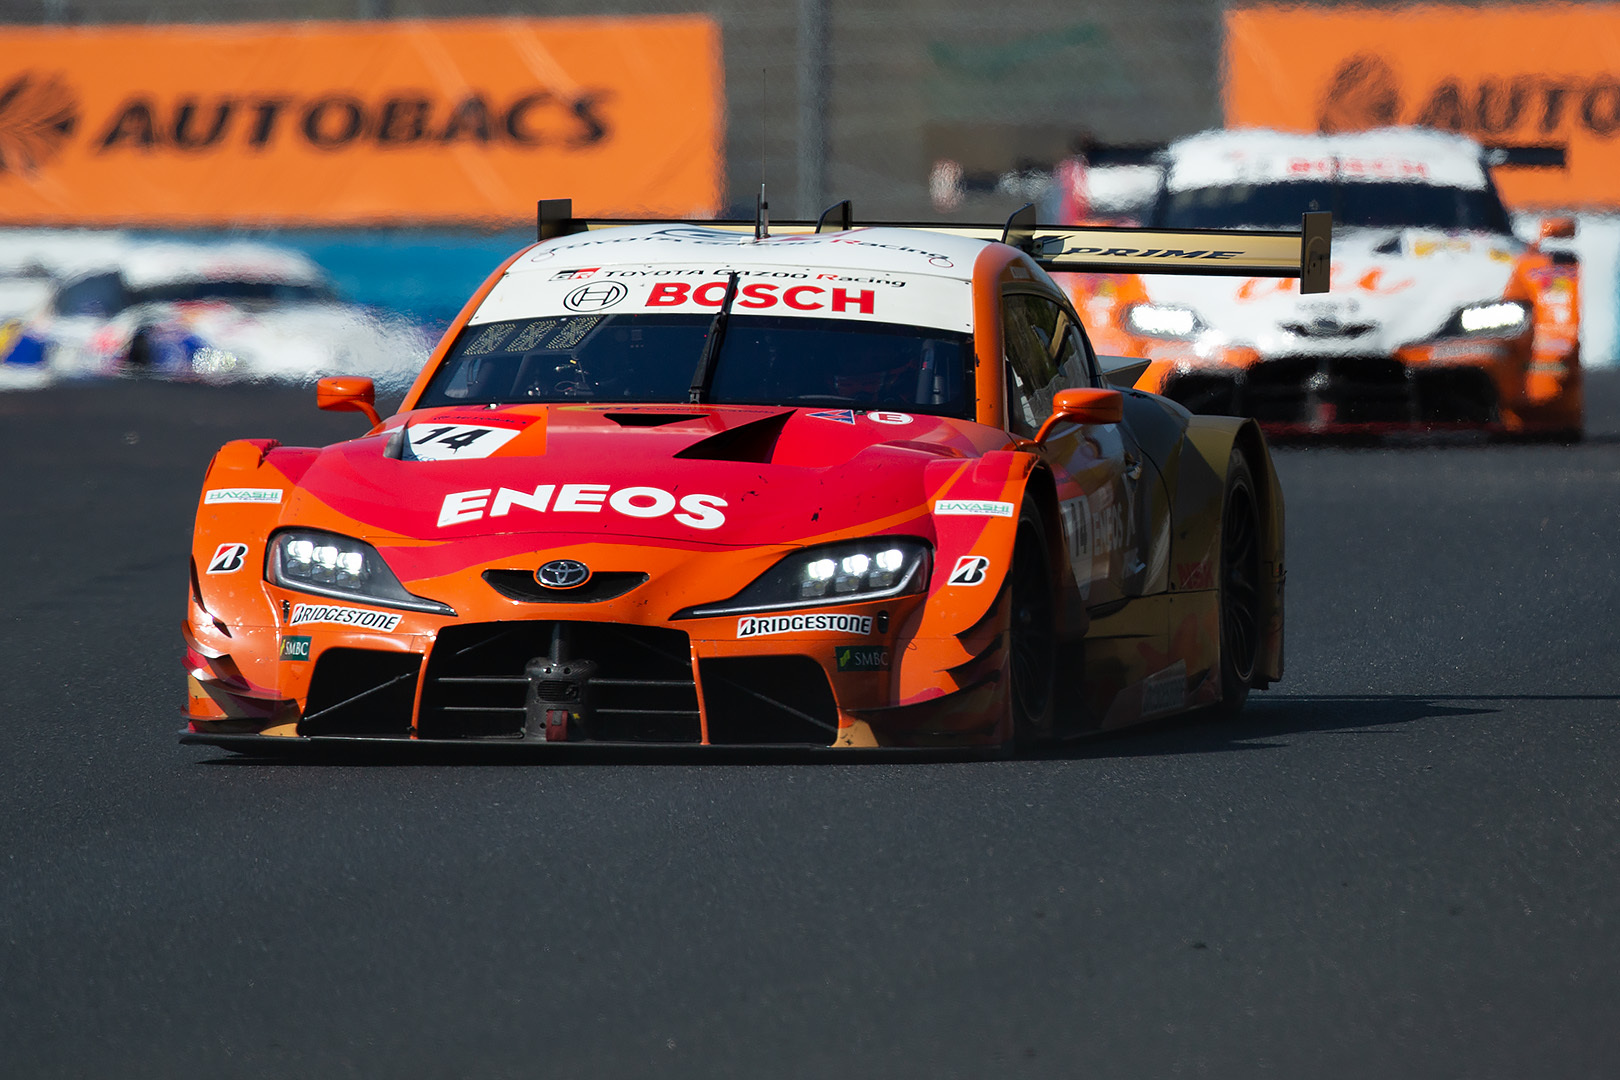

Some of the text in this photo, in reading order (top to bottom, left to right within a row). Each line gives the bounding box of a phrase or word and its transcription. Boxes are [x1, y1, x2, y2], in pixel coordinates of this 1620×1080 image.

[101, 92, 613, 152] AUTOBACS
[1065, 247, 1246, 260] PRIME
[816, 273, 906, 288] Racing
[645, 281, 875, 315] BOSCH
[412, 427, 493, 455] 14
[210, 490, 279, 499] HAYASHI
[437, 484, 728, 530] ENEOS
[940, 503, 1010, 513] HAYASHI
[1093, 502, 1124, 557] ENEOS
[291, 605, 399, 630] BRIDGESTONE
[740, 615, 872, 636] BRIDGESTONE
[285, 641, 310, 656] SMBC
[854, 651, 889, 666] SMBC
